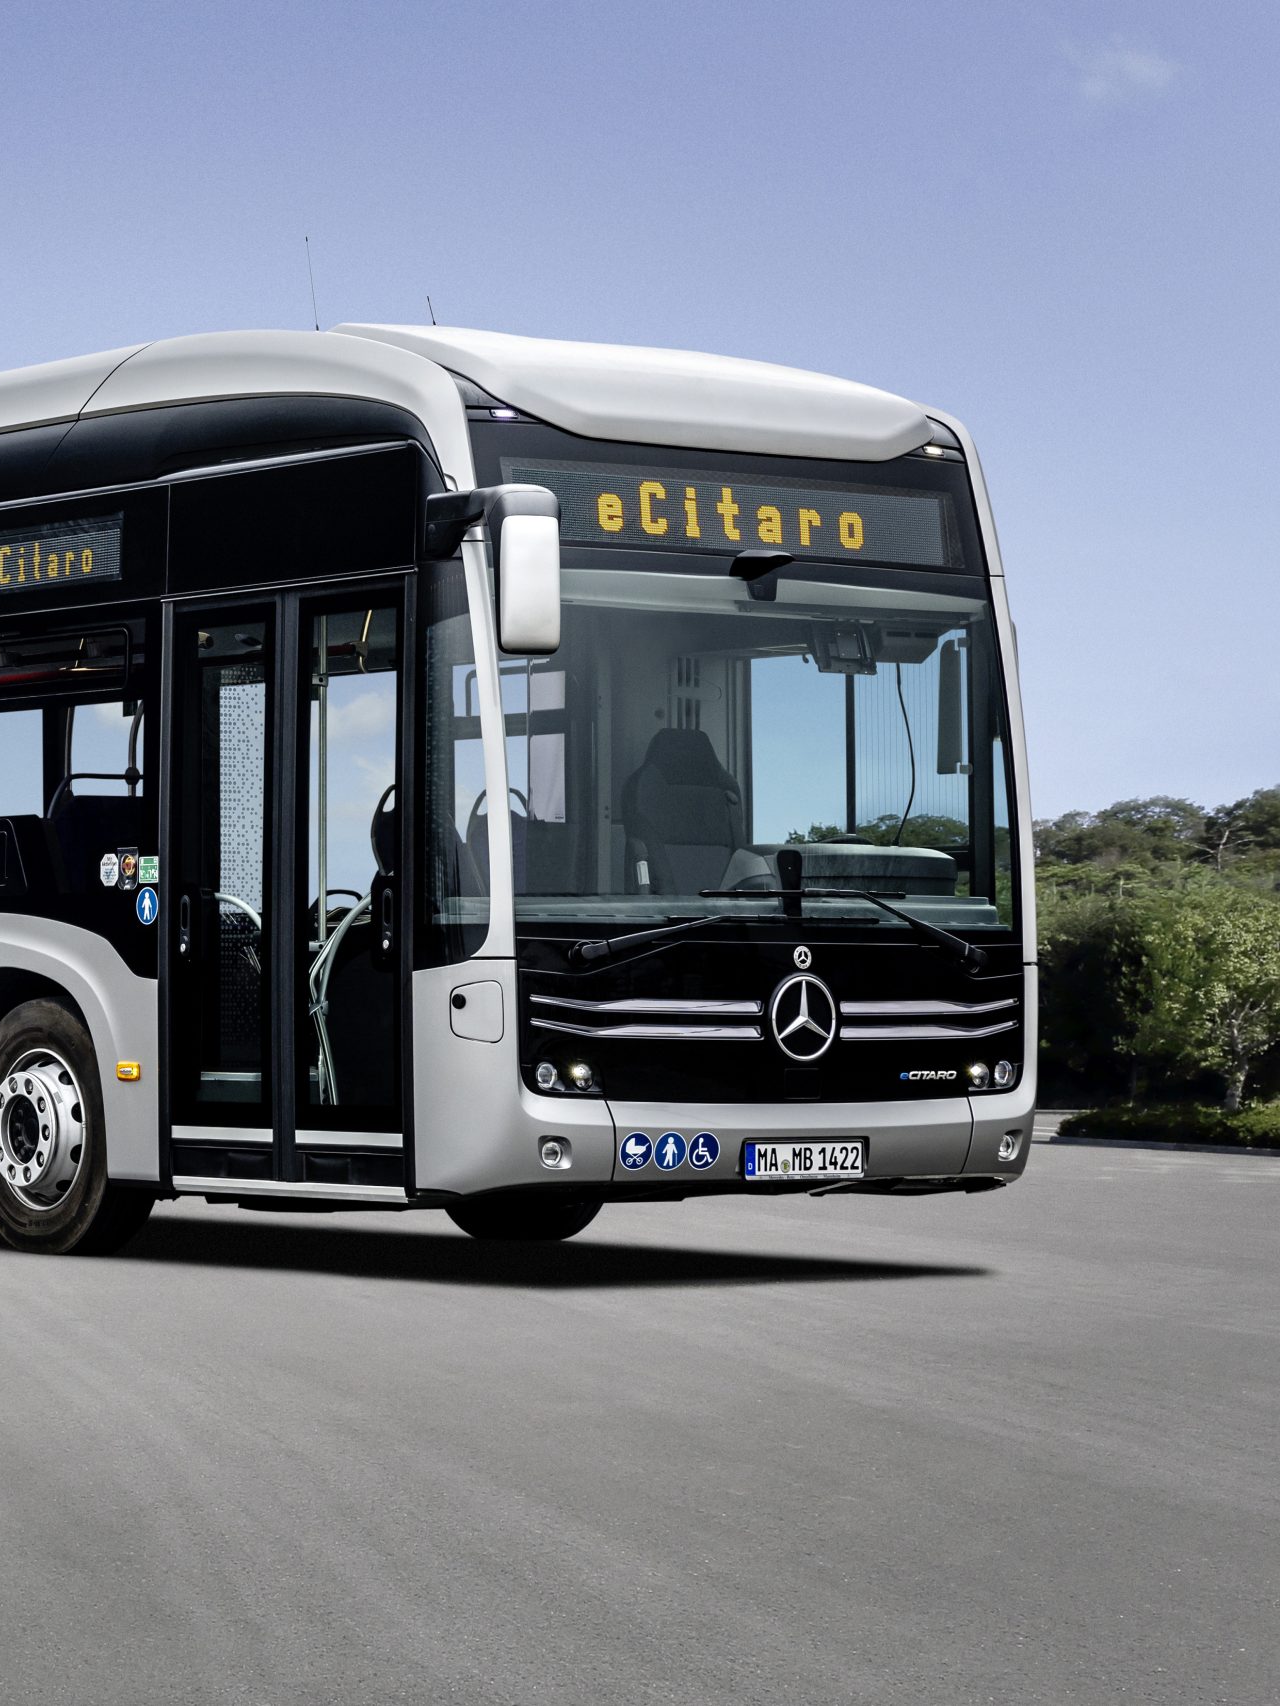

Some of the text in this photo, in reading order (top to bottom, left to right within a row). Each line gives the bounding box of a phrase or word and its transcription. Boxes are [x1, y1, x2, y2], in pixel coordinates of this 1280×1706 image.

[597, 481, 864, 550] eCitaro
[900, 1070, 957, 1080] eCITARO
[747, 1162, 753, 1170] D
[757, 1146, 860, 1172] MA MB 1422
